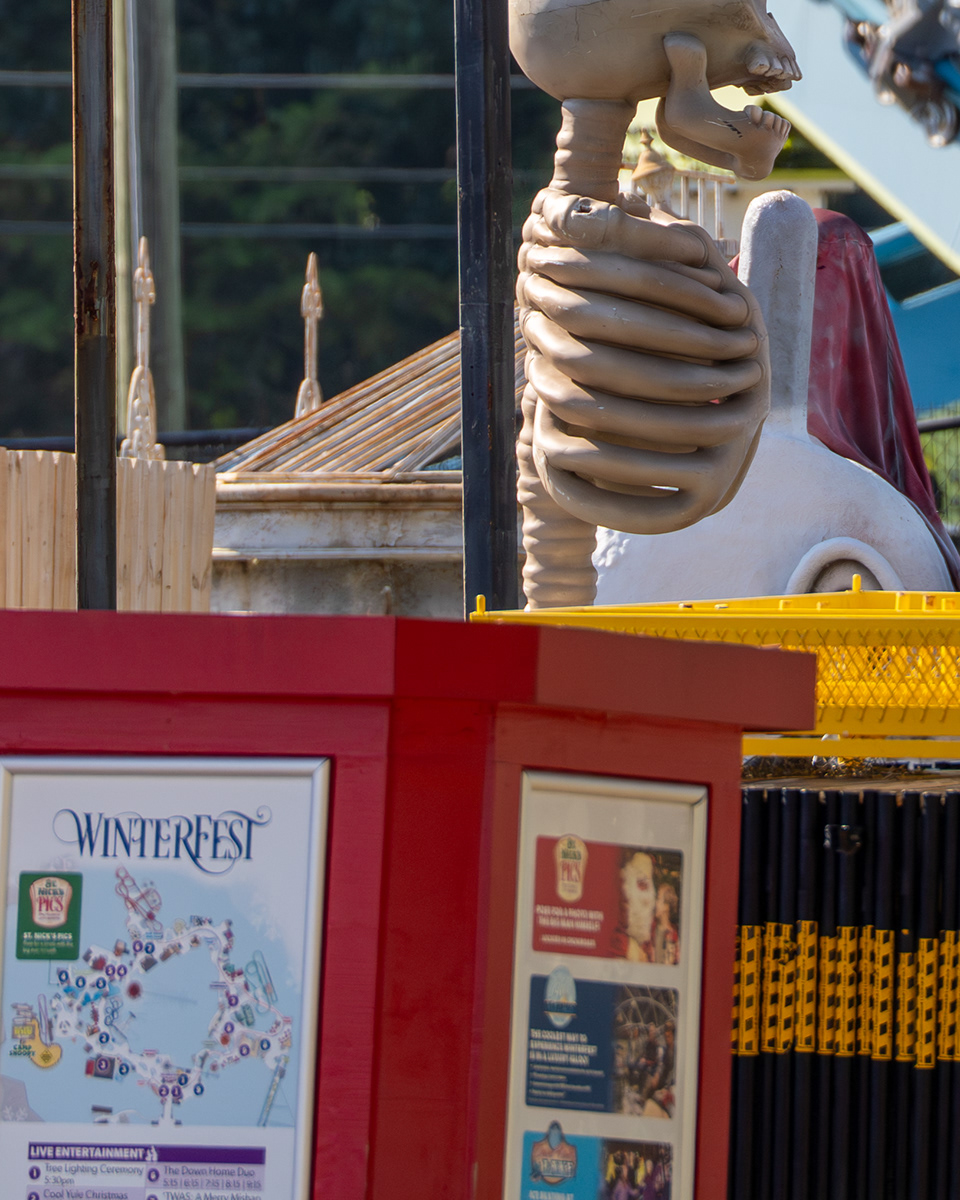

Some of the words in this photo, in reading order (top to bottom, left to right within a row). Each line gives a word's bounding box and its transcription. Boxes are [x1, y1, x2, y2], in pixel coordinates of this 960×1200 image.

[52, 805, 272, 875] WINTERFEST
[30, 1145, 54, 1157] LIVE
[55, 1146, 145, 1159] ENTERTAINMENT
[45, 1162, 63, 1172] Tree
[64, 1163, 98, 1175] Lighting
[100, 1163, 144, 1175] Ceremony
[163, 1165, 180, 1175] The
[181, 1165, 207, 1175] Down
[208, 1166, 236, 1177] Home
[237, 1166, 256, 1177] Duo
[43, 1188, 64, 1199] Cool
[66, 1188, 84, 1199] Yule
[85, 1189, 129, 1200] Christmas
